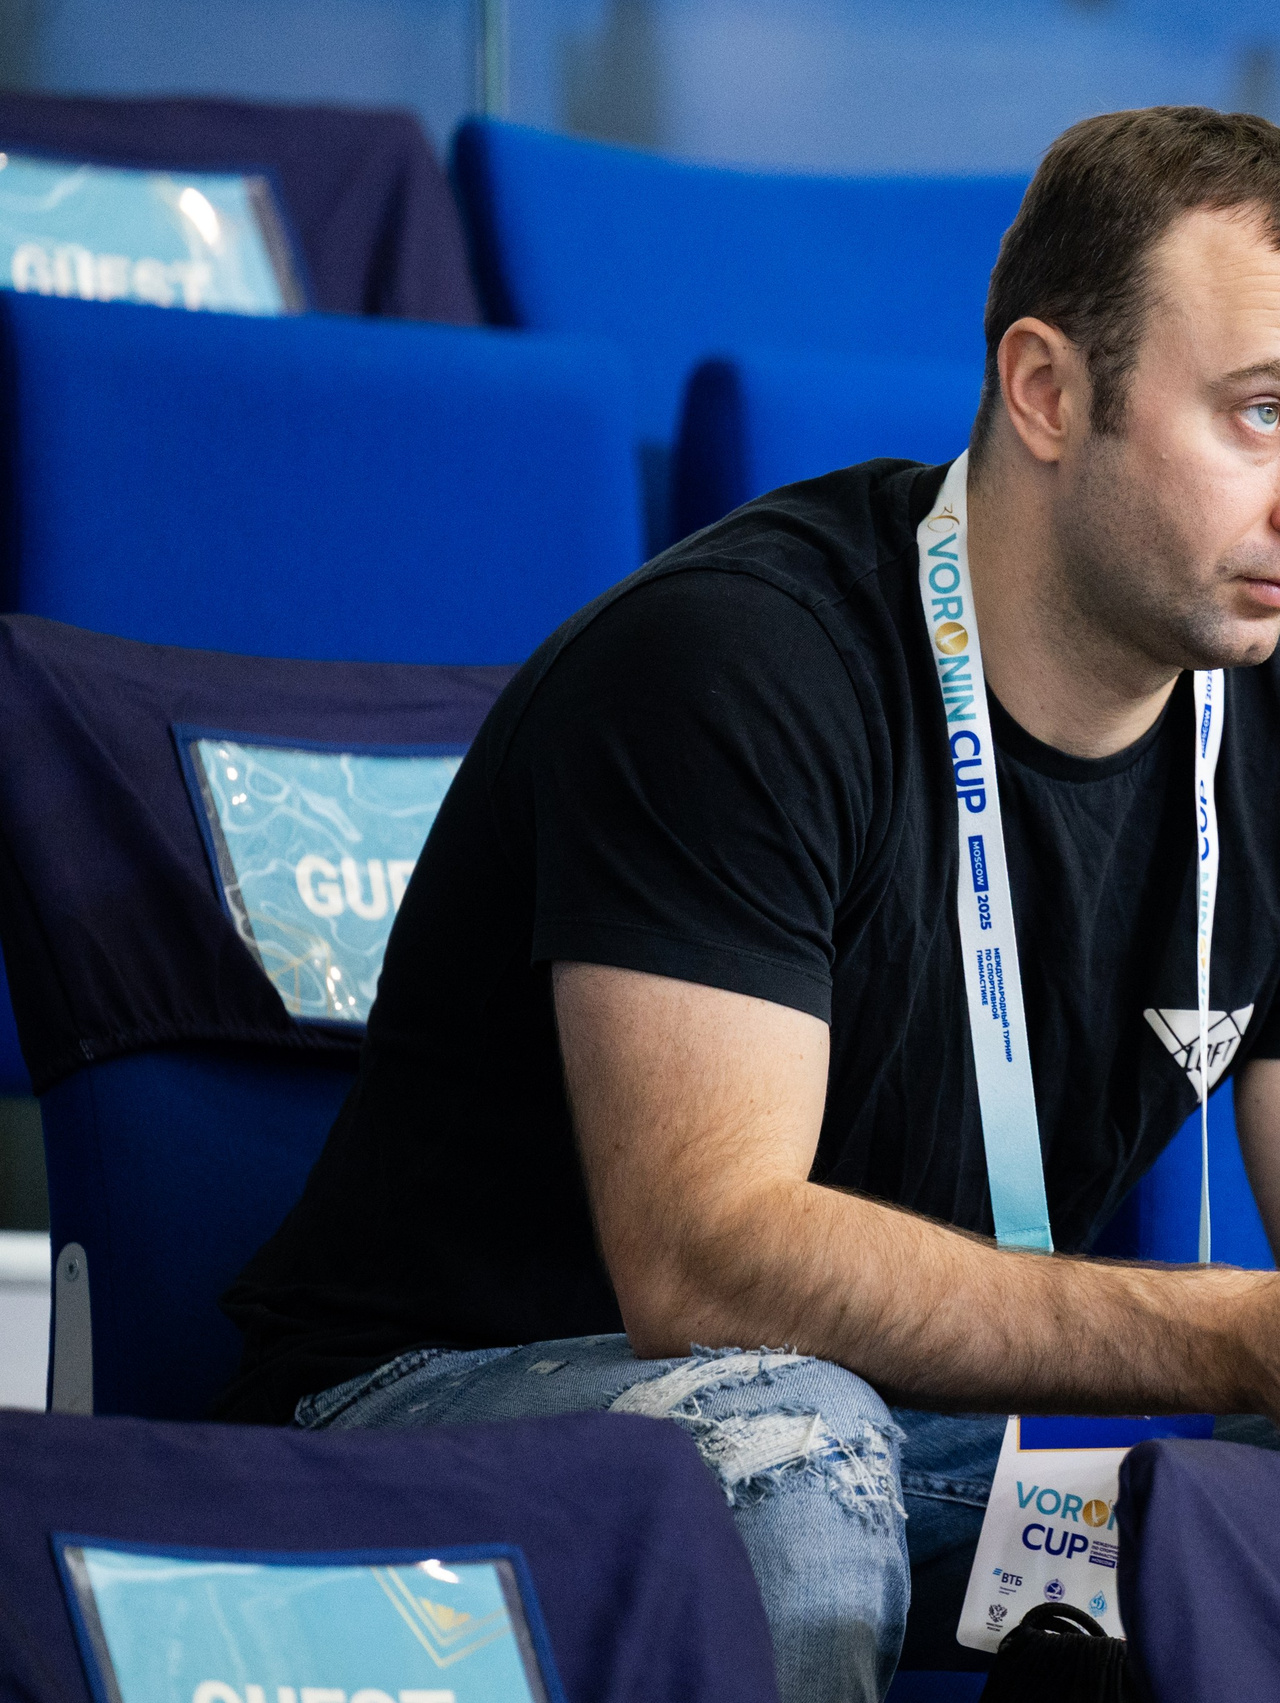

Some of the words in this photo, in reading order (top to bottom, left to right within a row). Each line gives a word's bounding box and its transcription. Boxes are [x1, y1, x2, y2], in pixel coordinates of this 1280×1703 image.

[928, 533, 977, 723] VORONIN
[950, 730, 987, 814] CUP
[972, 841, 985, 886] MOSCOW
[977, 894, 992, 931] 2025
[976, 950, 989, 1006] ГИМНАСТИКЕ
[985, 948, 993, 962] ПО
[986, 962, 1001, 1020] СПОРТИВНОЙ
[993, 947, 1011, 1028] МЕЖДУНАРОДНЫЙ
[1003, 1029, 1013, 1063] ТУРНИР
[1022, 1523, 1089, 1560] CUP
[1001, 1572, 1023, 1587] ВТБ
